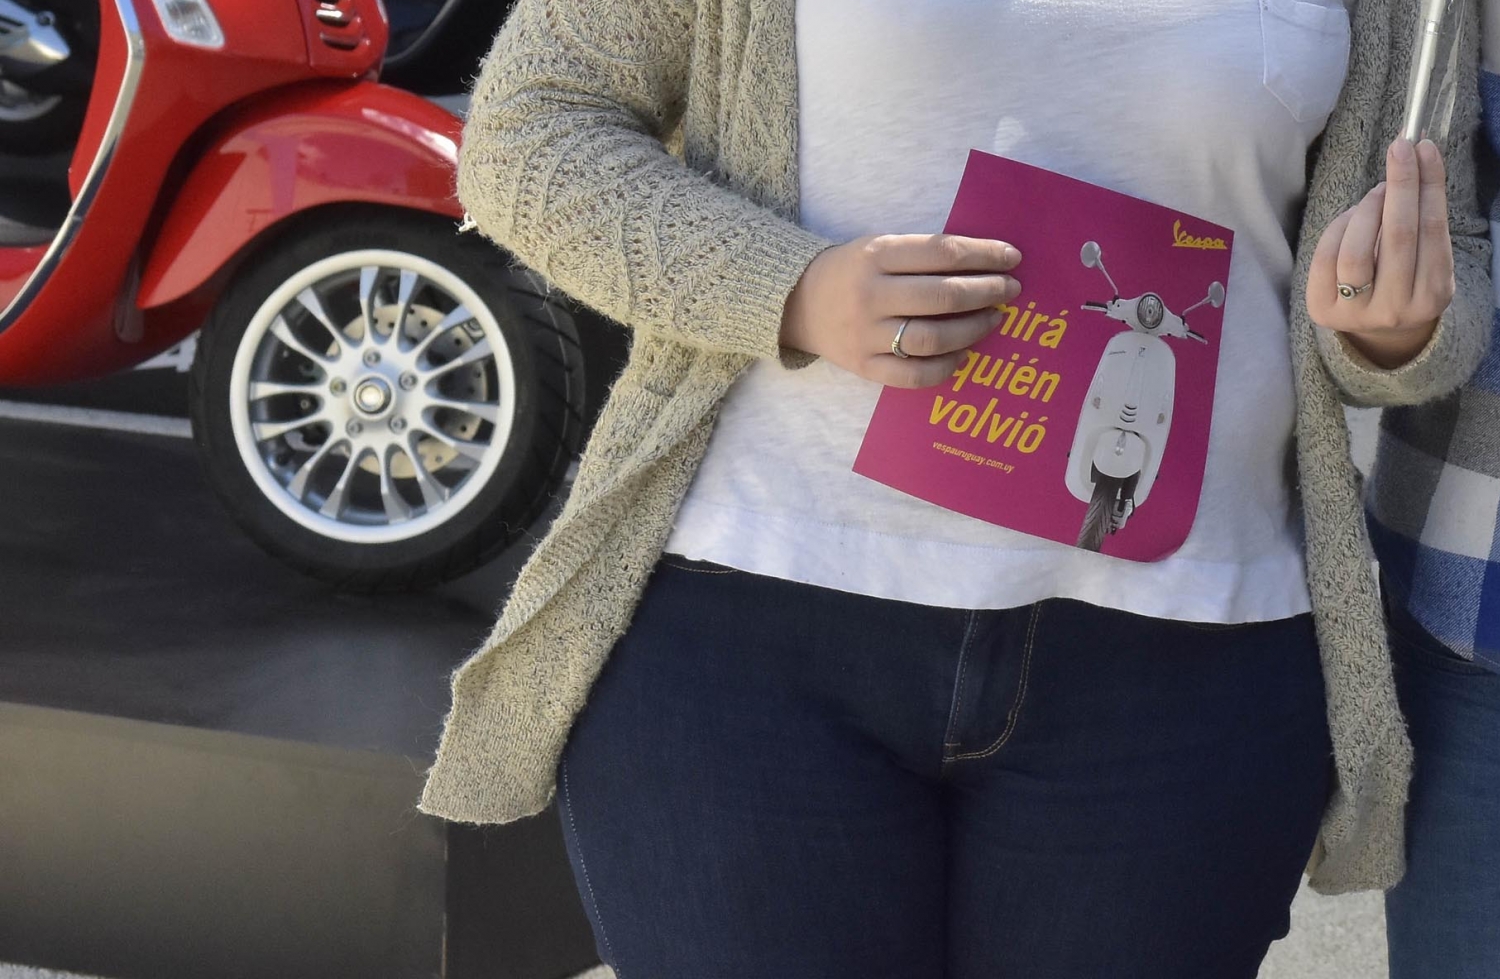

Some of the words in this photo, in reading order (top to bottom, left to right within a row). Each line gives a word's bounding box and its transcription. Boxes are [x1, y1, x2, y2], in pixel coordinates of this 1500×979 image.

[1172, 219, 1228, 250] Vespa
[952, 349, 1061, 403] quién
[929, 395, 1049, 454] volvió
[932, 440, 1015, 474] vespauruguay.com.uy
